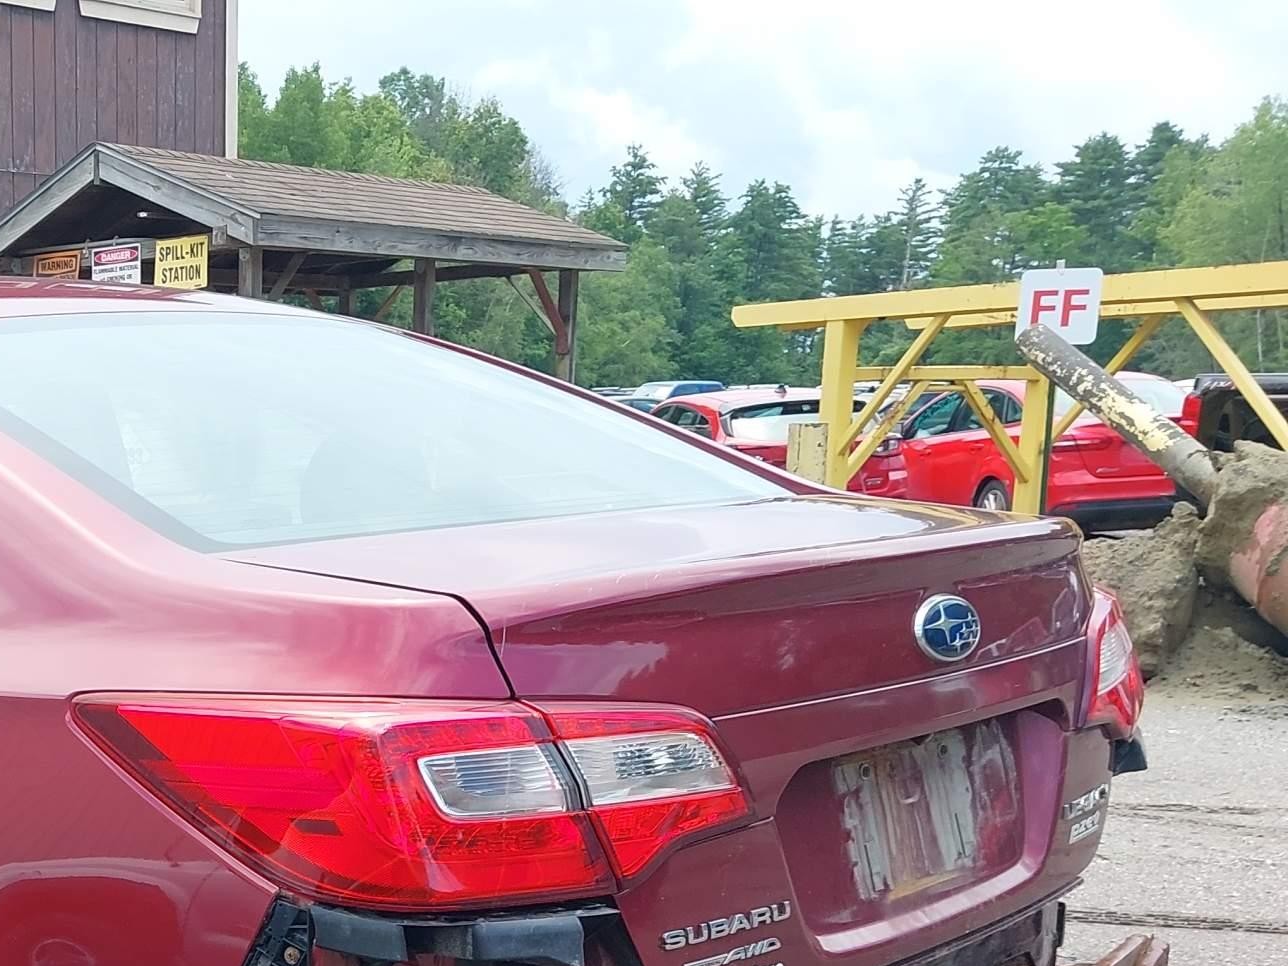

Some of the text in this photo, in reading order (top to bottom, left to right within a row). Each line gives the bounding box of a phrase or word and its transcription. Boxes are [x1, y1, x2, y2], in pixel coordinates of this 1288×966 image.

[101, 250, 131, 262] DANGER
[159, 241, 205, 262] SPILL-KIT
[39, 258, 74, 272] WARNING
[161, 263, 202, 284] STATION
[1030, 289, 1090, 327] FF
[662, 901, 792, 951] SUBARU
[723, 937, 782, 965] AWD
